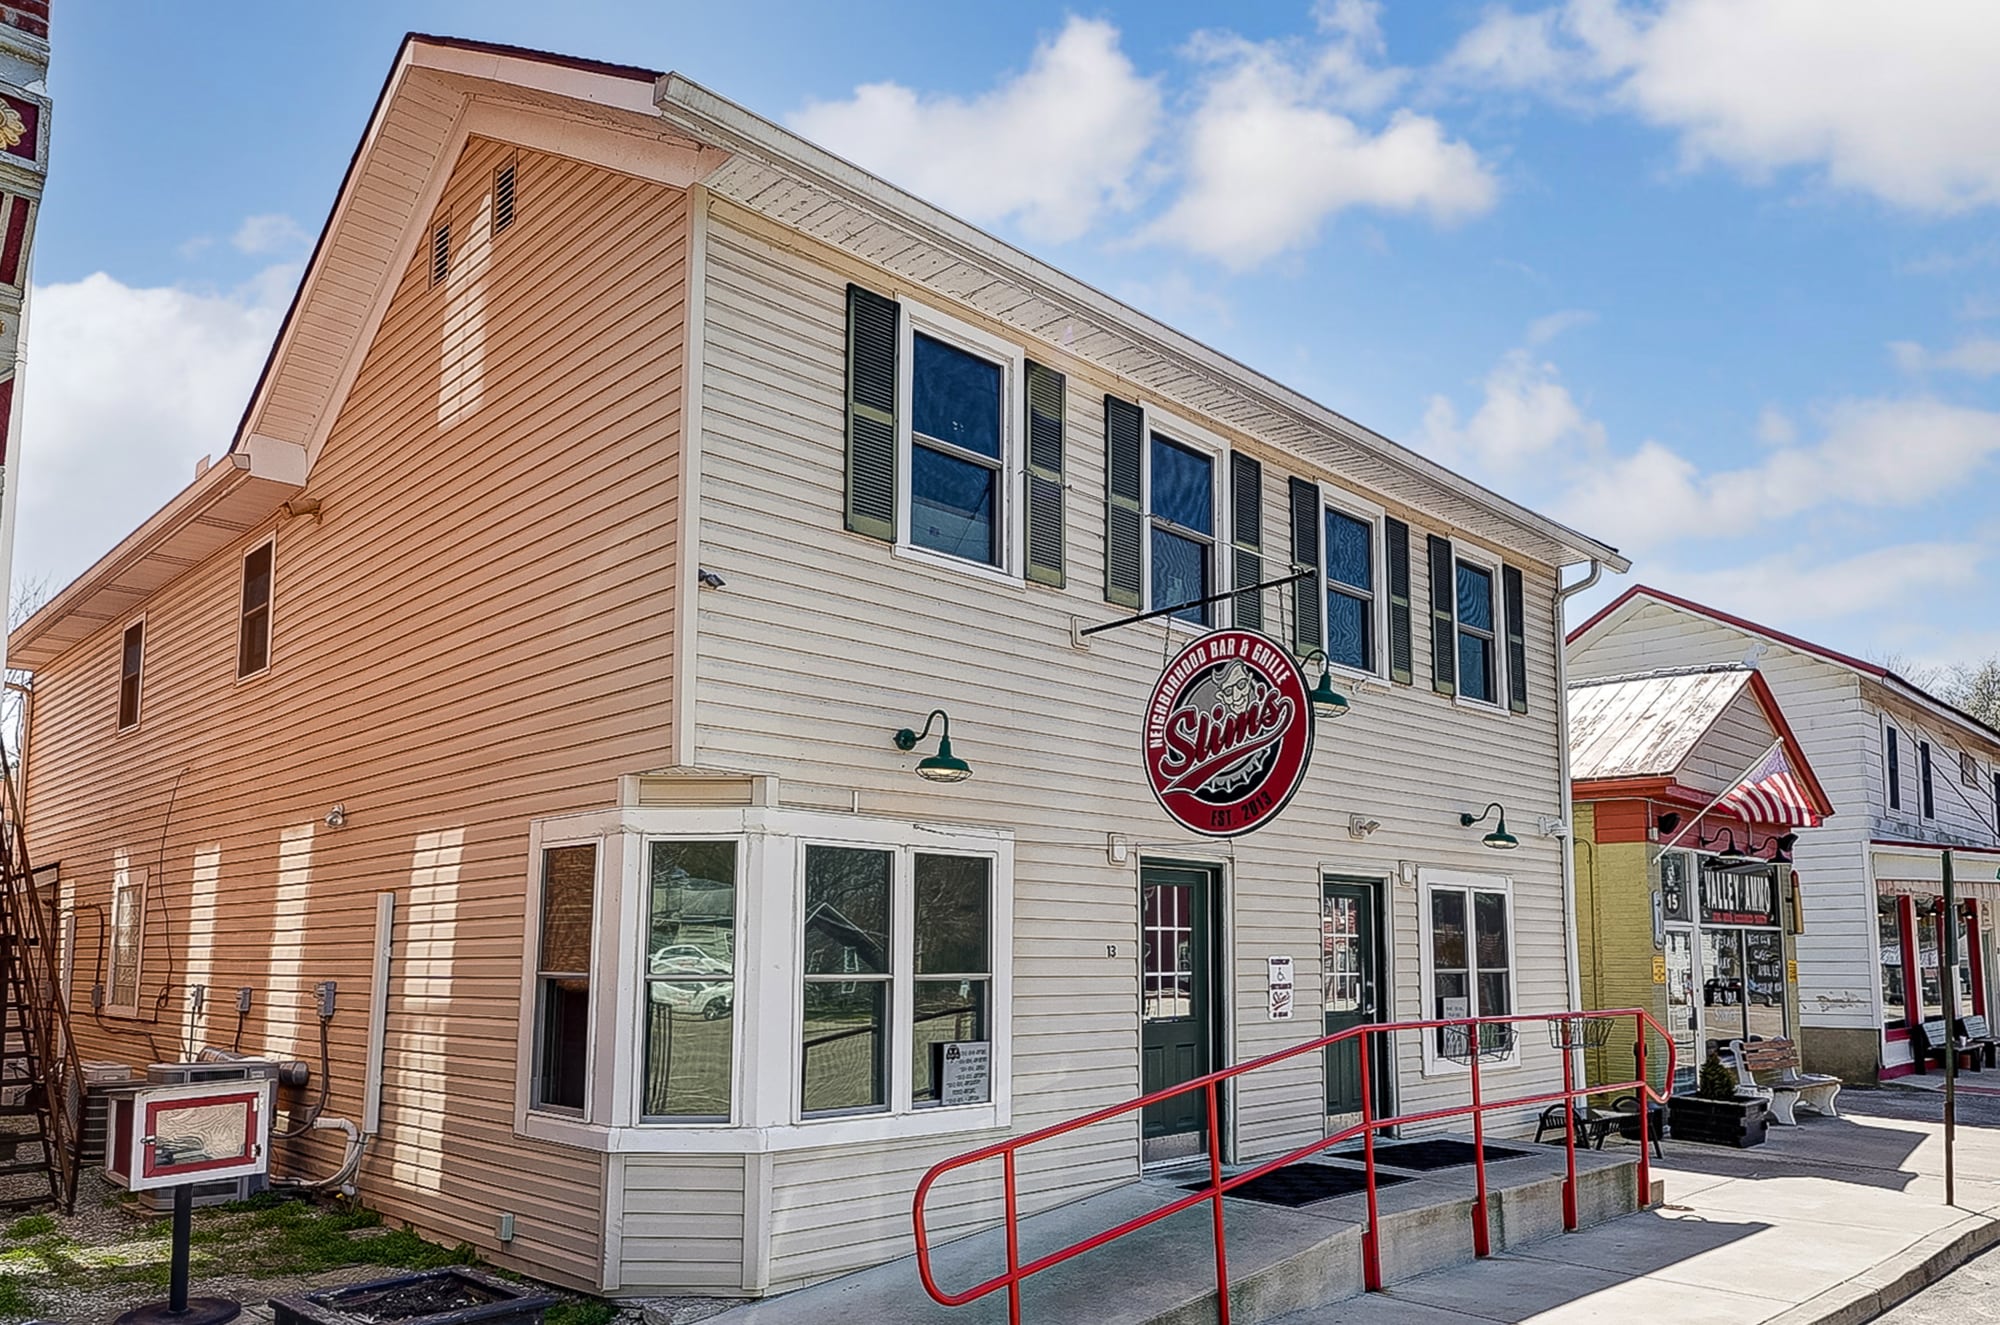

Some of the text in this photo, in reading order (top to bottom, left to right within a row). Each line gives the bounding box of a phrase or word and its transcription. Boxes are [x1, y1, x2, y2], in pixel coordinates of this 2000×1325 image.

[1150, 638, 1291, 749] NEIGHBORHOOD BAR & GRILLE
[1160, 682, 1284, 779] Slim's
[1241, 790, 1273, 821] 2013
[1667, 893, 1679, 909] 15
[1704, 870, 1739, 911] VALLEY
[1745, 875, 1771, 913] AMMO
[1106, 945, 1117, 959] 13
